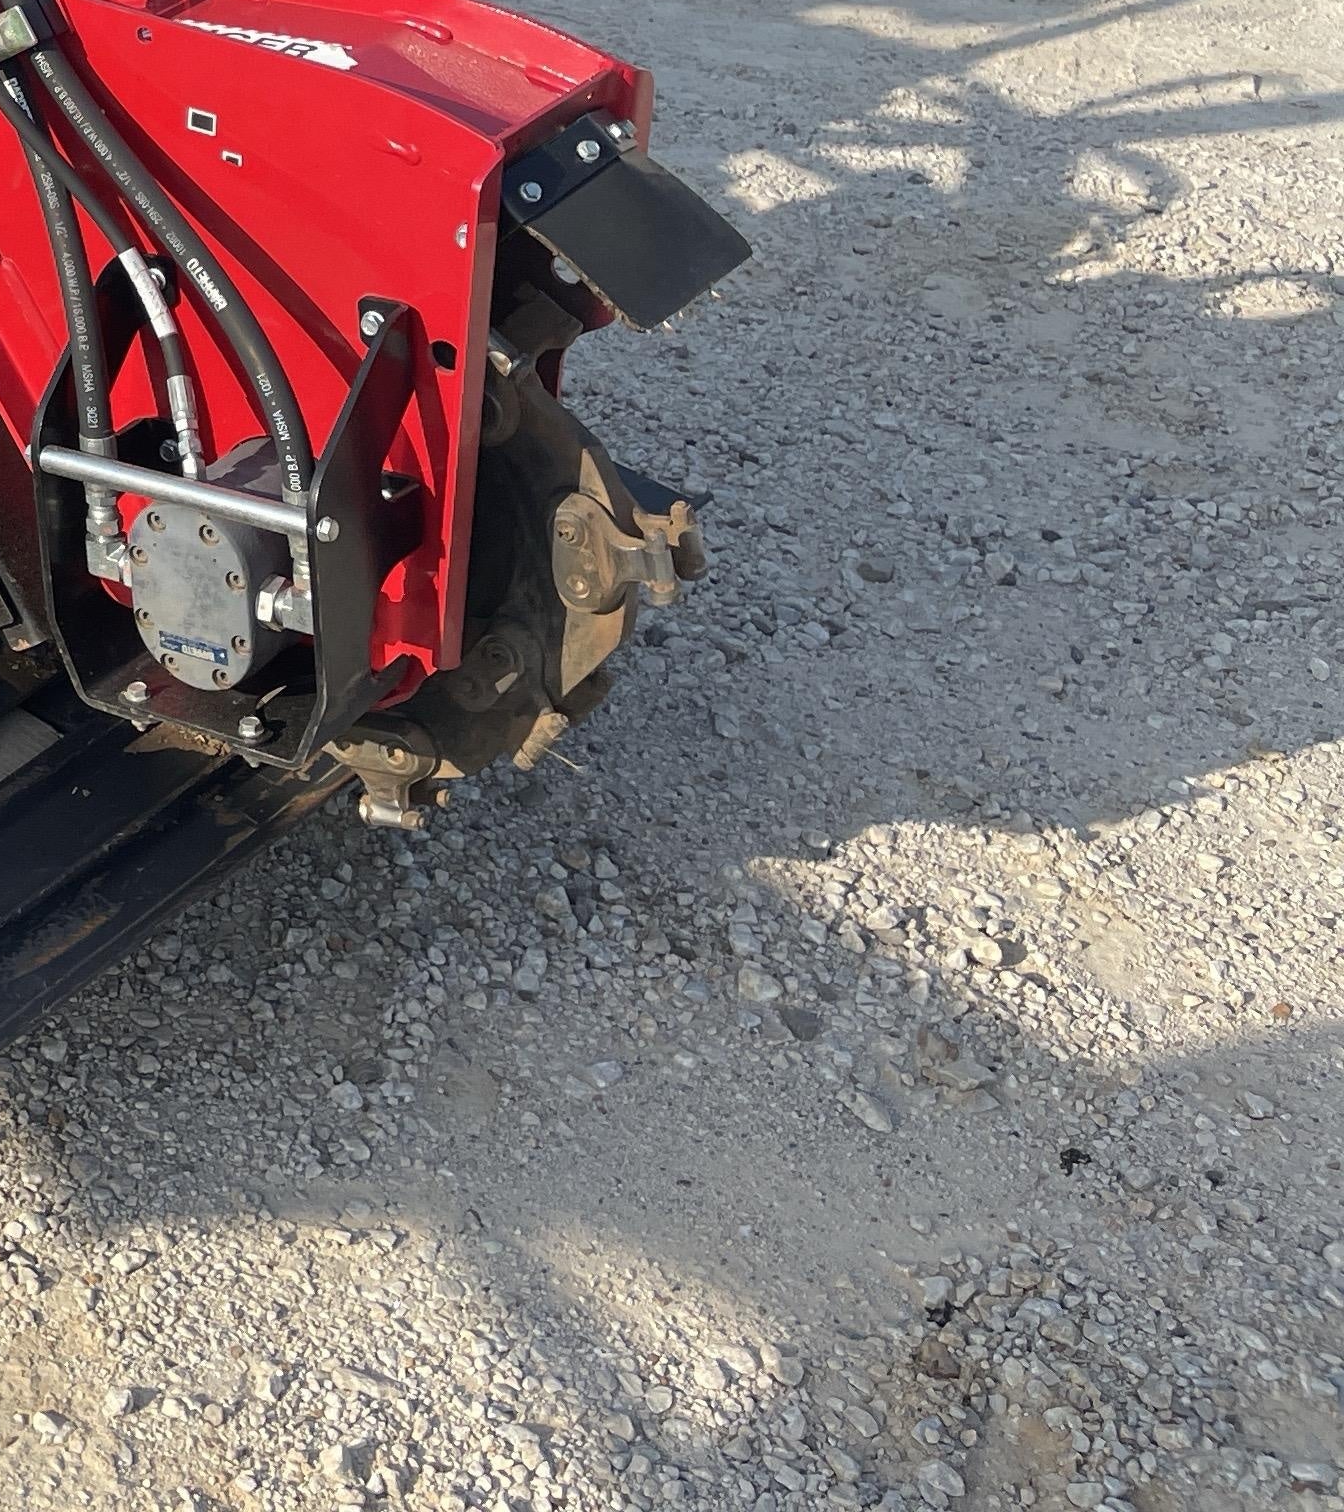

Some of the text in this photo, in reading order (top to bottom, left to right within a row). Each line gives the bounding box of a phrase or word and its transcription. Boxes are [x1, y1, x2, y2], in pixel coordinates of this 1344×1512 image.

[34, 52, 54, 79] MSHA
[186, 257, 228, 312] BARRETO
[81, 363, 95, 393] MSHA
[272, 409, 291, 441] MSHA
